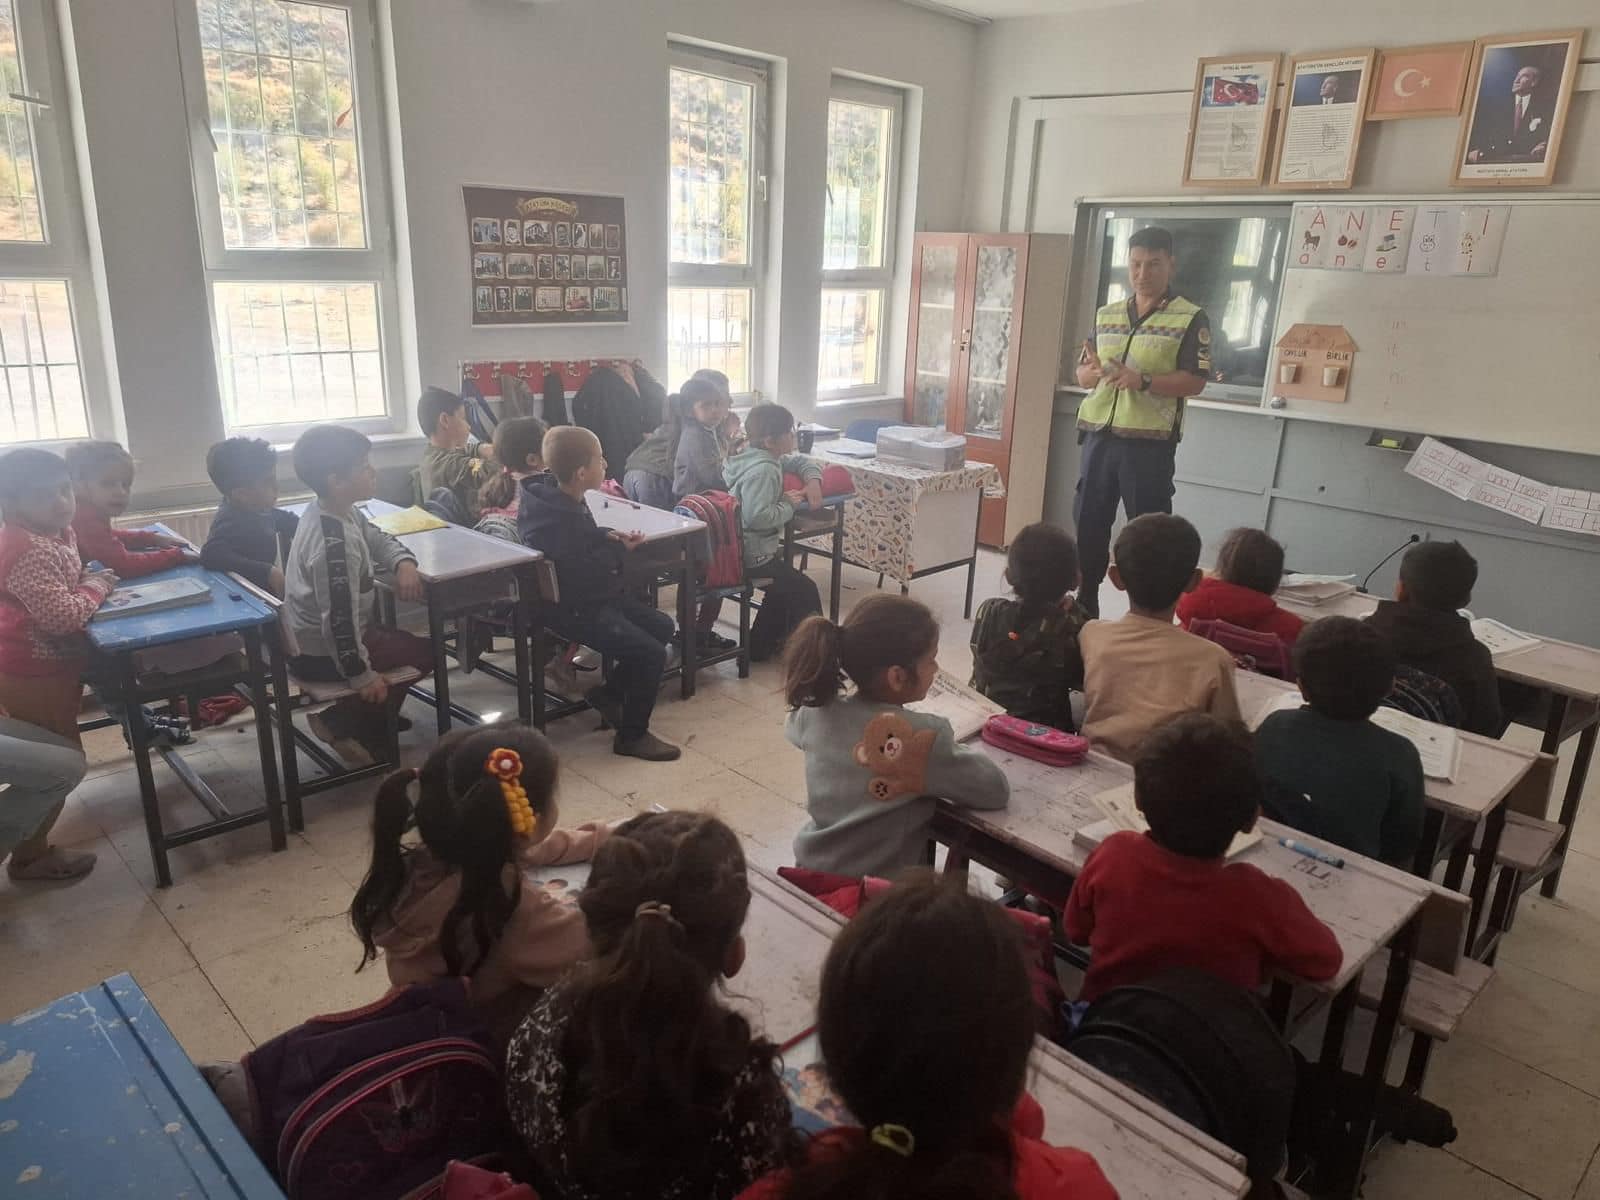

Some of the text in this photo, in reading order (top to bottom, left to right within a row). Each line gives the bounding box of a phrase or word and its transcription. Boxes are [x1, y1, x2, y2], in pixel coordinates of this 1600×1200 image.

[1310, 209, 1327, 231] A
[1347, 210, 1365, 231] N
[1389, 209, 1405, 231] E
[1375, 256, 1387, 269] e
